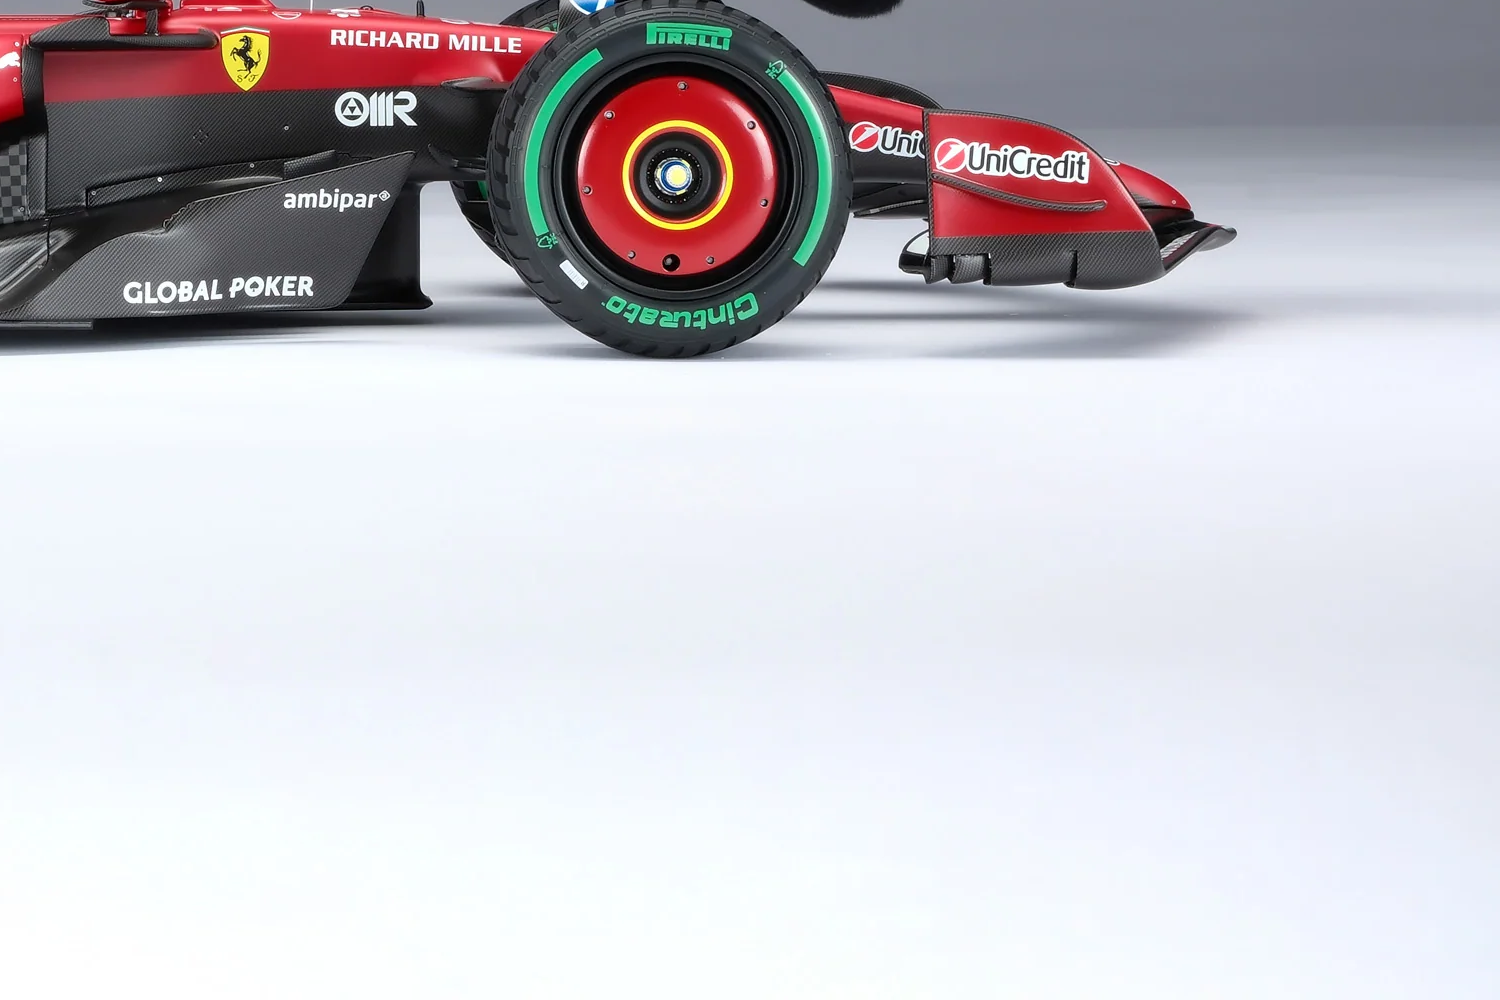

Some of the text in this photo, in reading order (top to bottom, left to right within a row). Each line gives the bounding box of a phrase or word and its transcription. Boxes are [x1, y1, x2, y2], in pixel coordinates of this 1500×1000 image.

[330, 29, 522, 53] RICHARD MILLE
[646, 22, 733, 51] PIRELLI
[968, 145, 1087, 182] UniCredit
[284, 188, 377, 212] ambipar
[123, 276, 314, 304] GLOBAL POKER
